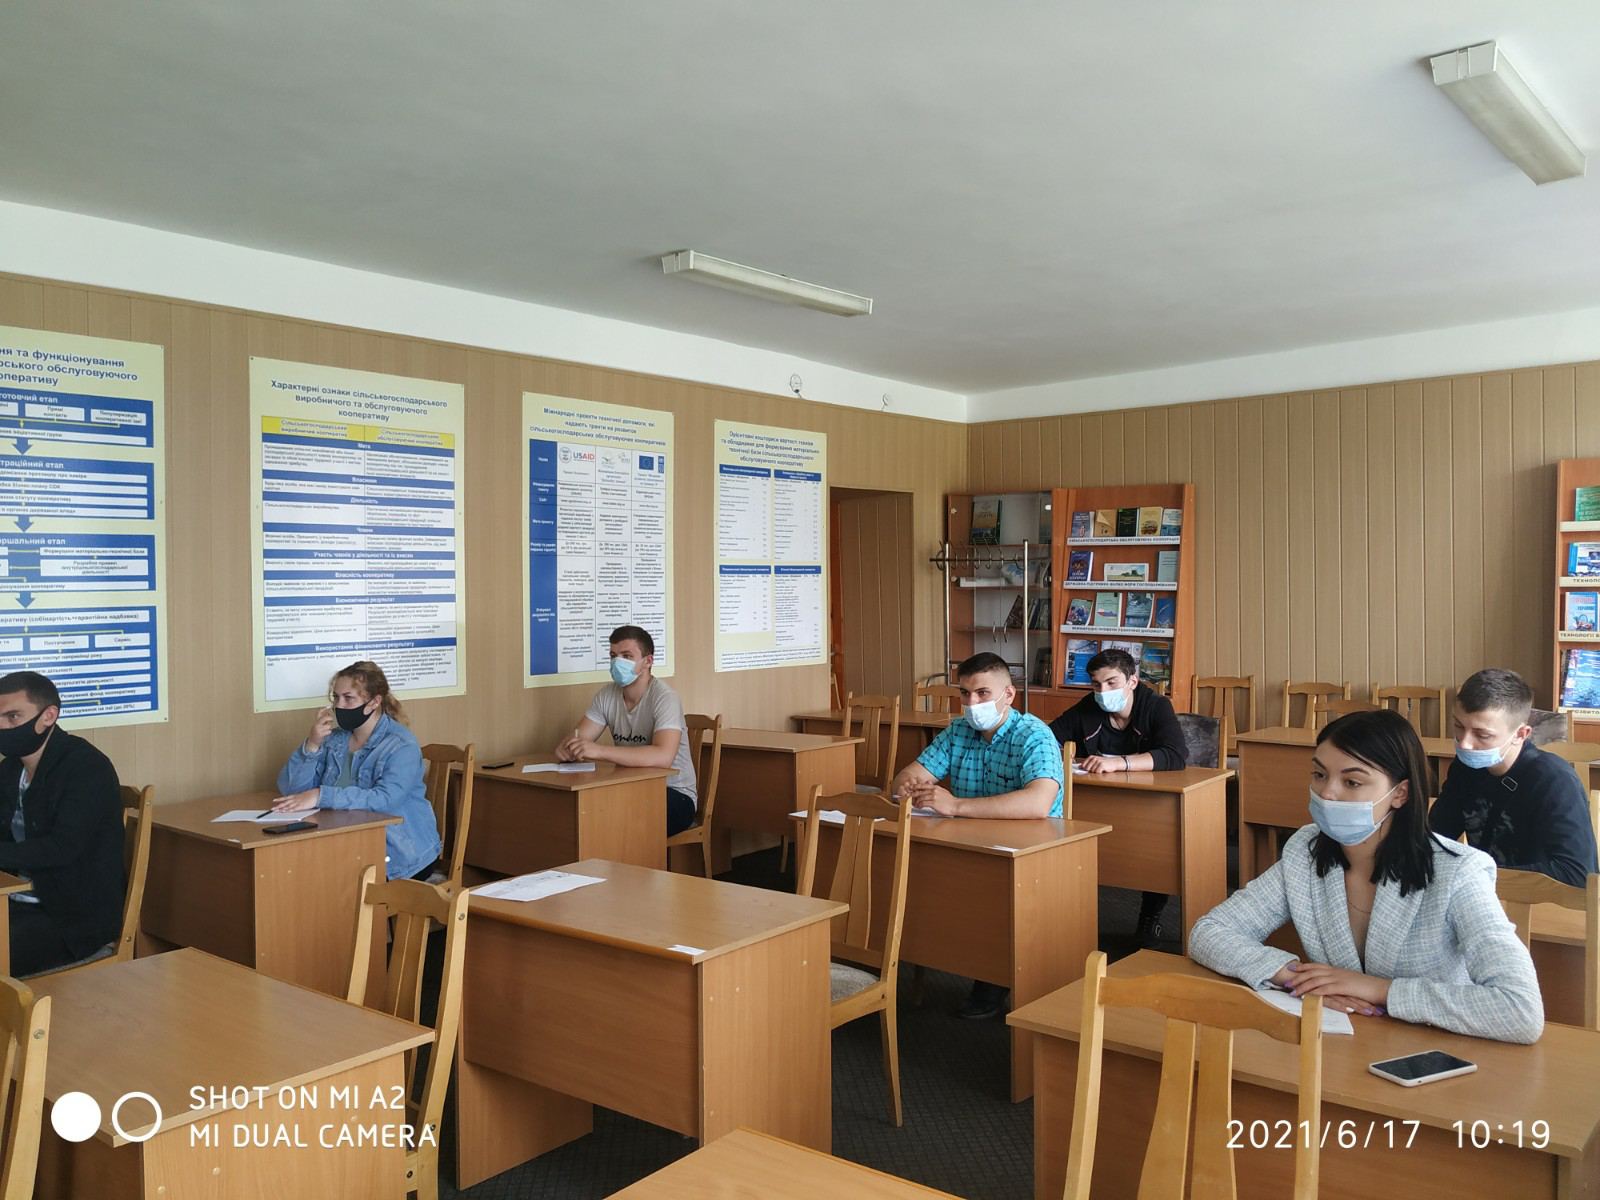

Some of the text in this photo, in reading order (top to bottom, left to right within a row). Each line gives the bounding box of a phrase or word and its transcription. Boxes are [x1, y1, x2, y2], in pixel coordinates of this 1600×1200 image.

[16, 349, 29, 357] та
[32, 349, 125, 368] функціонування
[47, 364, 138, 381] обслуговуючого
[271, 380, 448, 408] Характерні ознаки сільськогосподарського
[295, 395, 351, 408] виробничого
[364, 402, 428, 416] обслуговуючого
[543, 407, 576, 417] Міжнародні
[338, 410, 390, 422] кооперативу
[573, 452, 595, 461] USAID
[0, 537, 66, 546] ршальний етап
